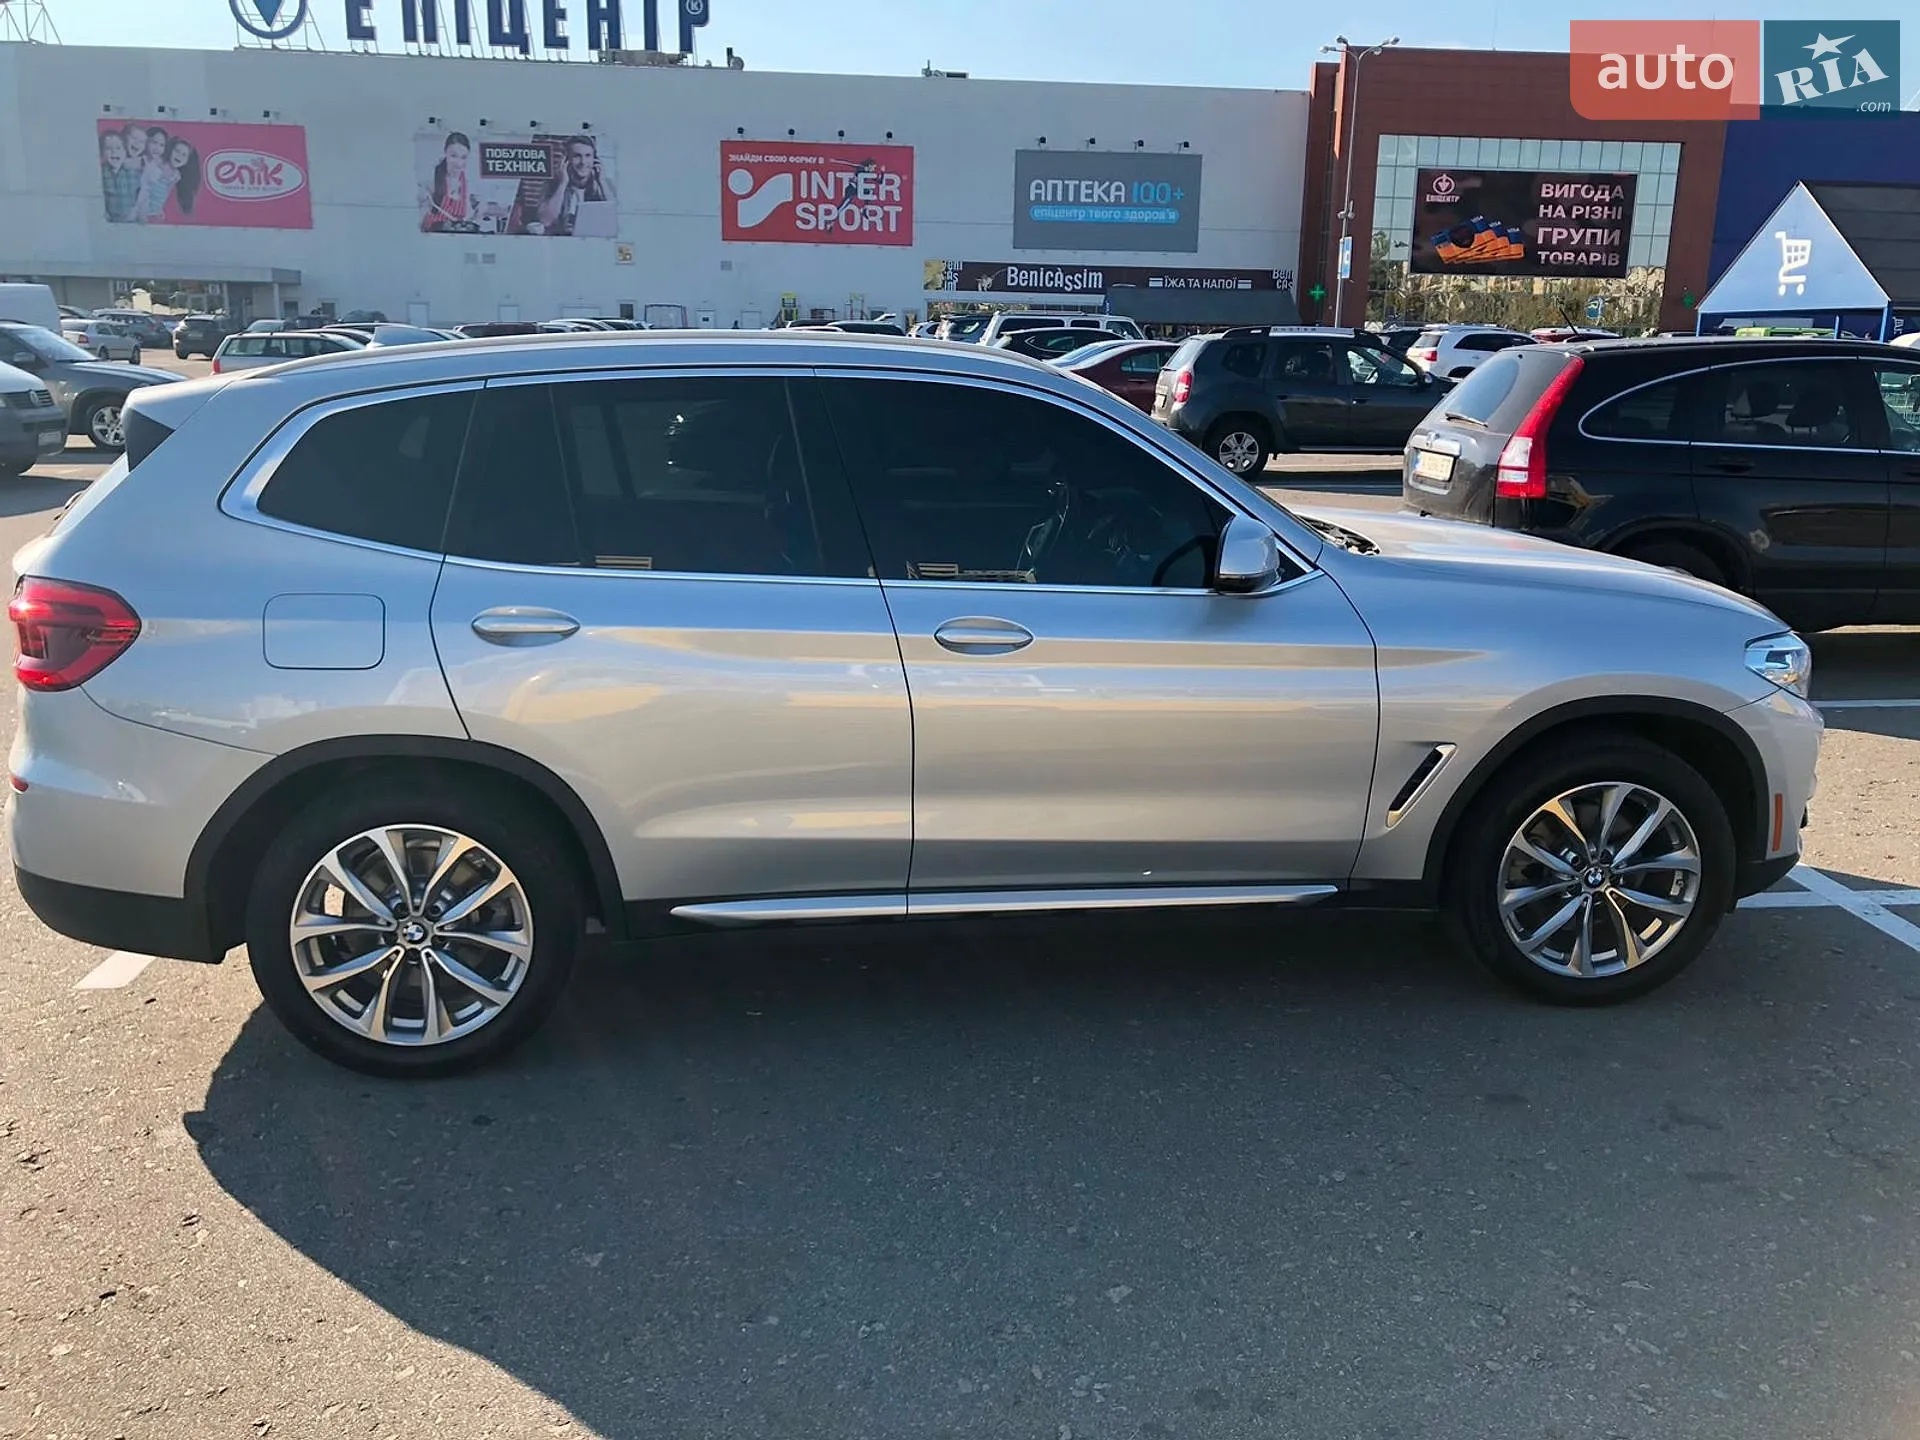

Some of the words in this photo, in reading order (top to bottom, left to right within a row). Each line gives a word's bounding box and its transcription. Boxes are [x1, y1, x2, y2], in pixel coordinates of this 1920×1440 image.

[485, 148, 547, 160] ПОБУТОВА
[763, 154, 787, 163] СВОЮ
[486, 160, 547, 173] ТЕХНІКА
[800, 170, 901, 201] INTER
[1029, 179, 1126, 203] АПТЕКА
[1131, 181, 1185, 204] 100+
[1540, 183, 1624, 202] ВИГОДА
[795, 202, 903, 232] SPORT
[1539, 204, 1566, 218] НА
[1571, 205, 1622, 220] РІЗНІ
[1537, 227, 1620, 246] ГРУПИ
[1537, 251, 1620, 267] ТОВАРІВ
[1164, 275, 1186, 288] ЇЖА
[1187, 278, 1201, 289] ТА
[1202, 276, 1237, 289] НАПОЇ
